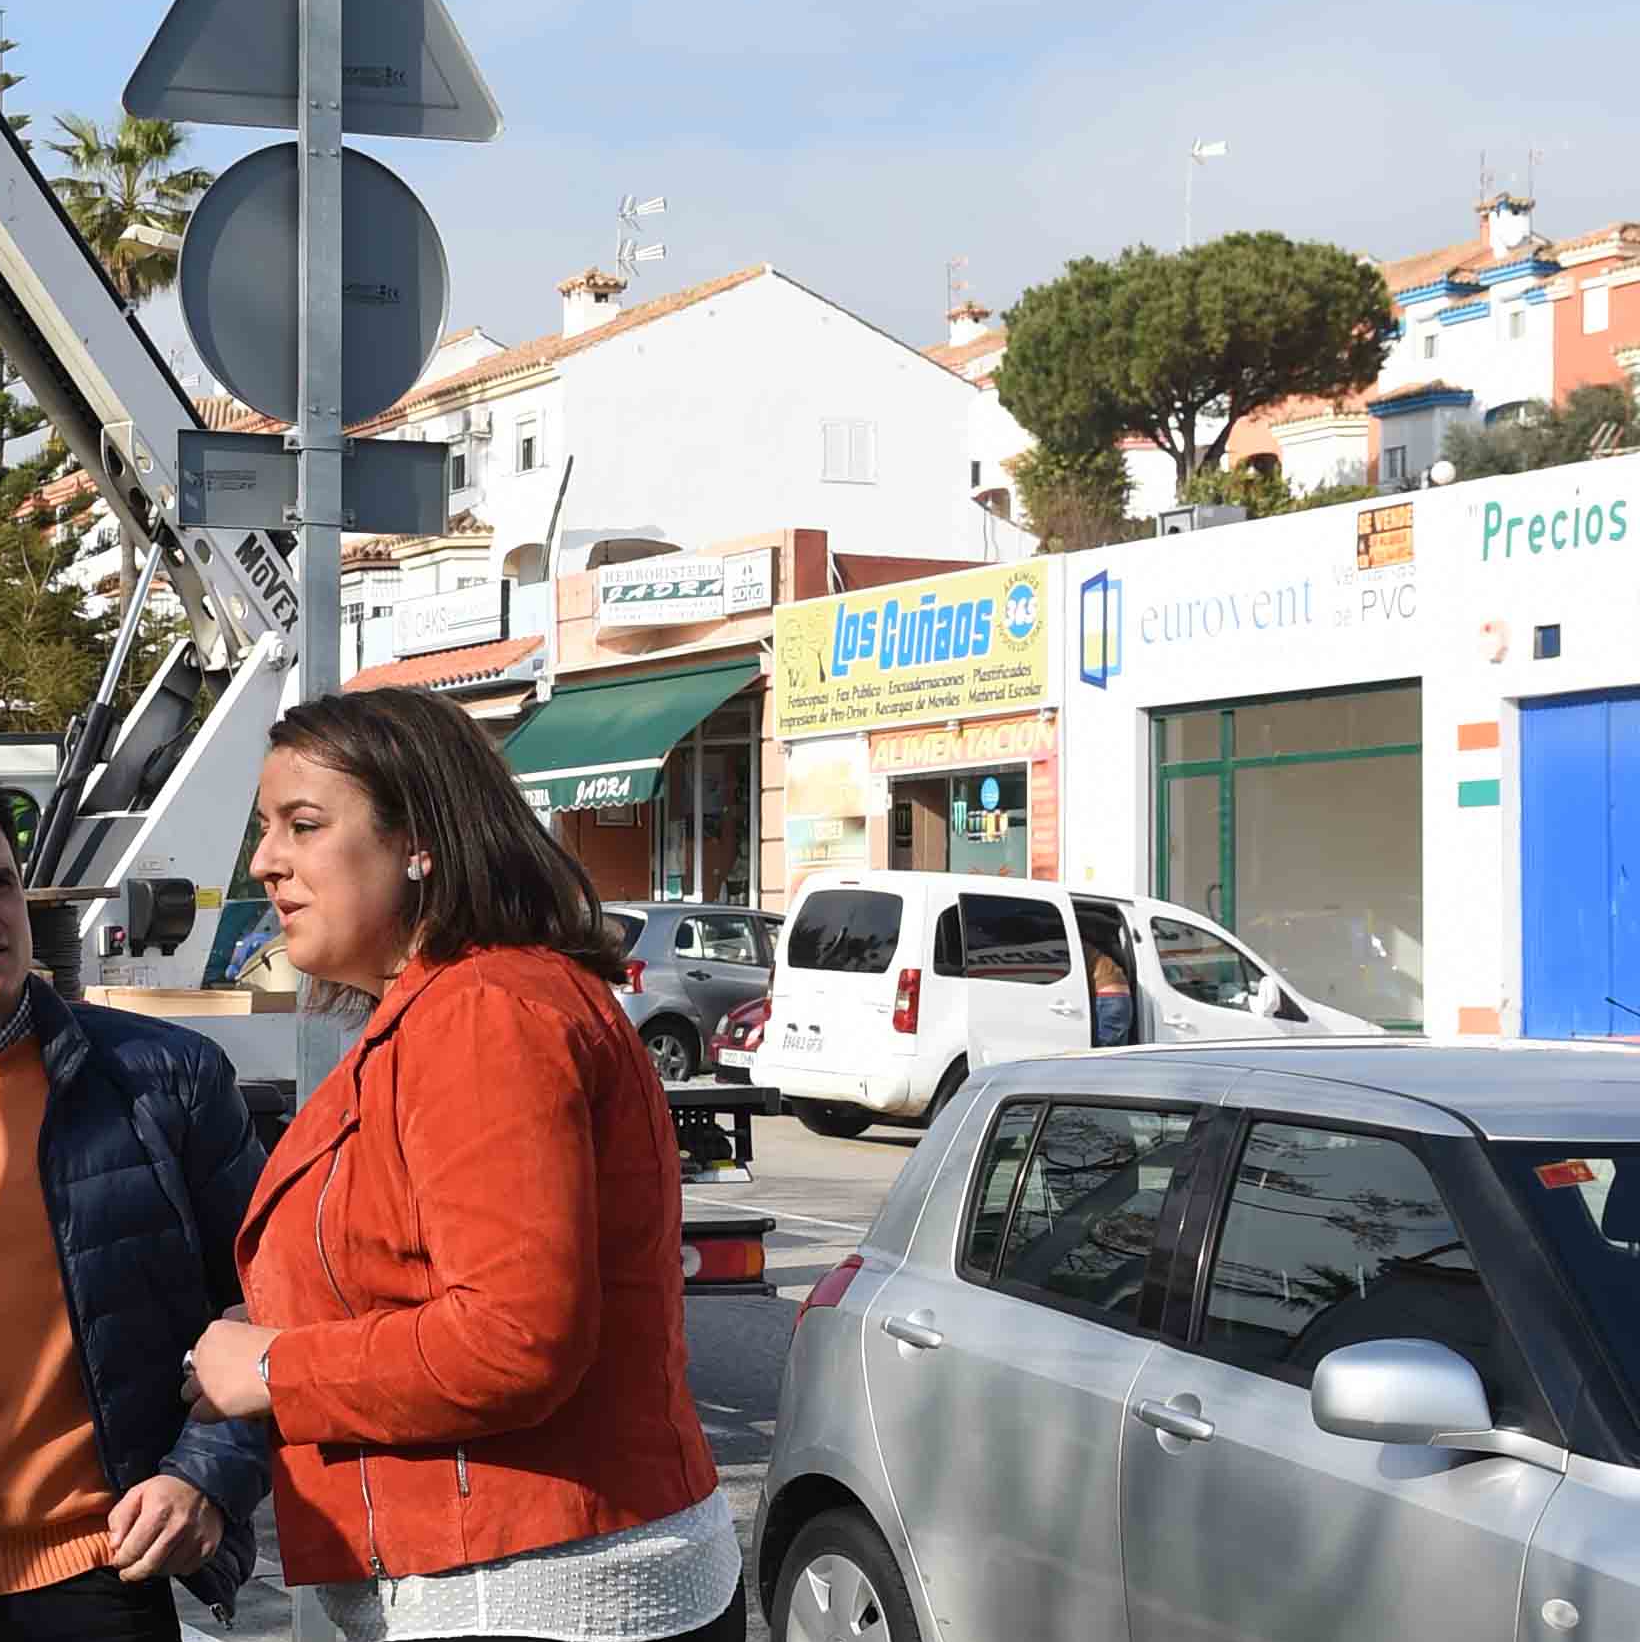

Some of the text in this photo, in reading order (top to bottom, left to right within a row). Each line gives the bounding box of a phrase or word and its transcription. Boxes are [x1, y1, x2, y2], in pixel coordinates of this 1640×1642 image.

[234, 532, 299, 635] MOVEX
[1139, 576, 1313, 645] eurovent
[1361, 582, 1417, 622] PVC
[831, 602, 878, 677] Los
[574, 775, 632, 805] JADRA
